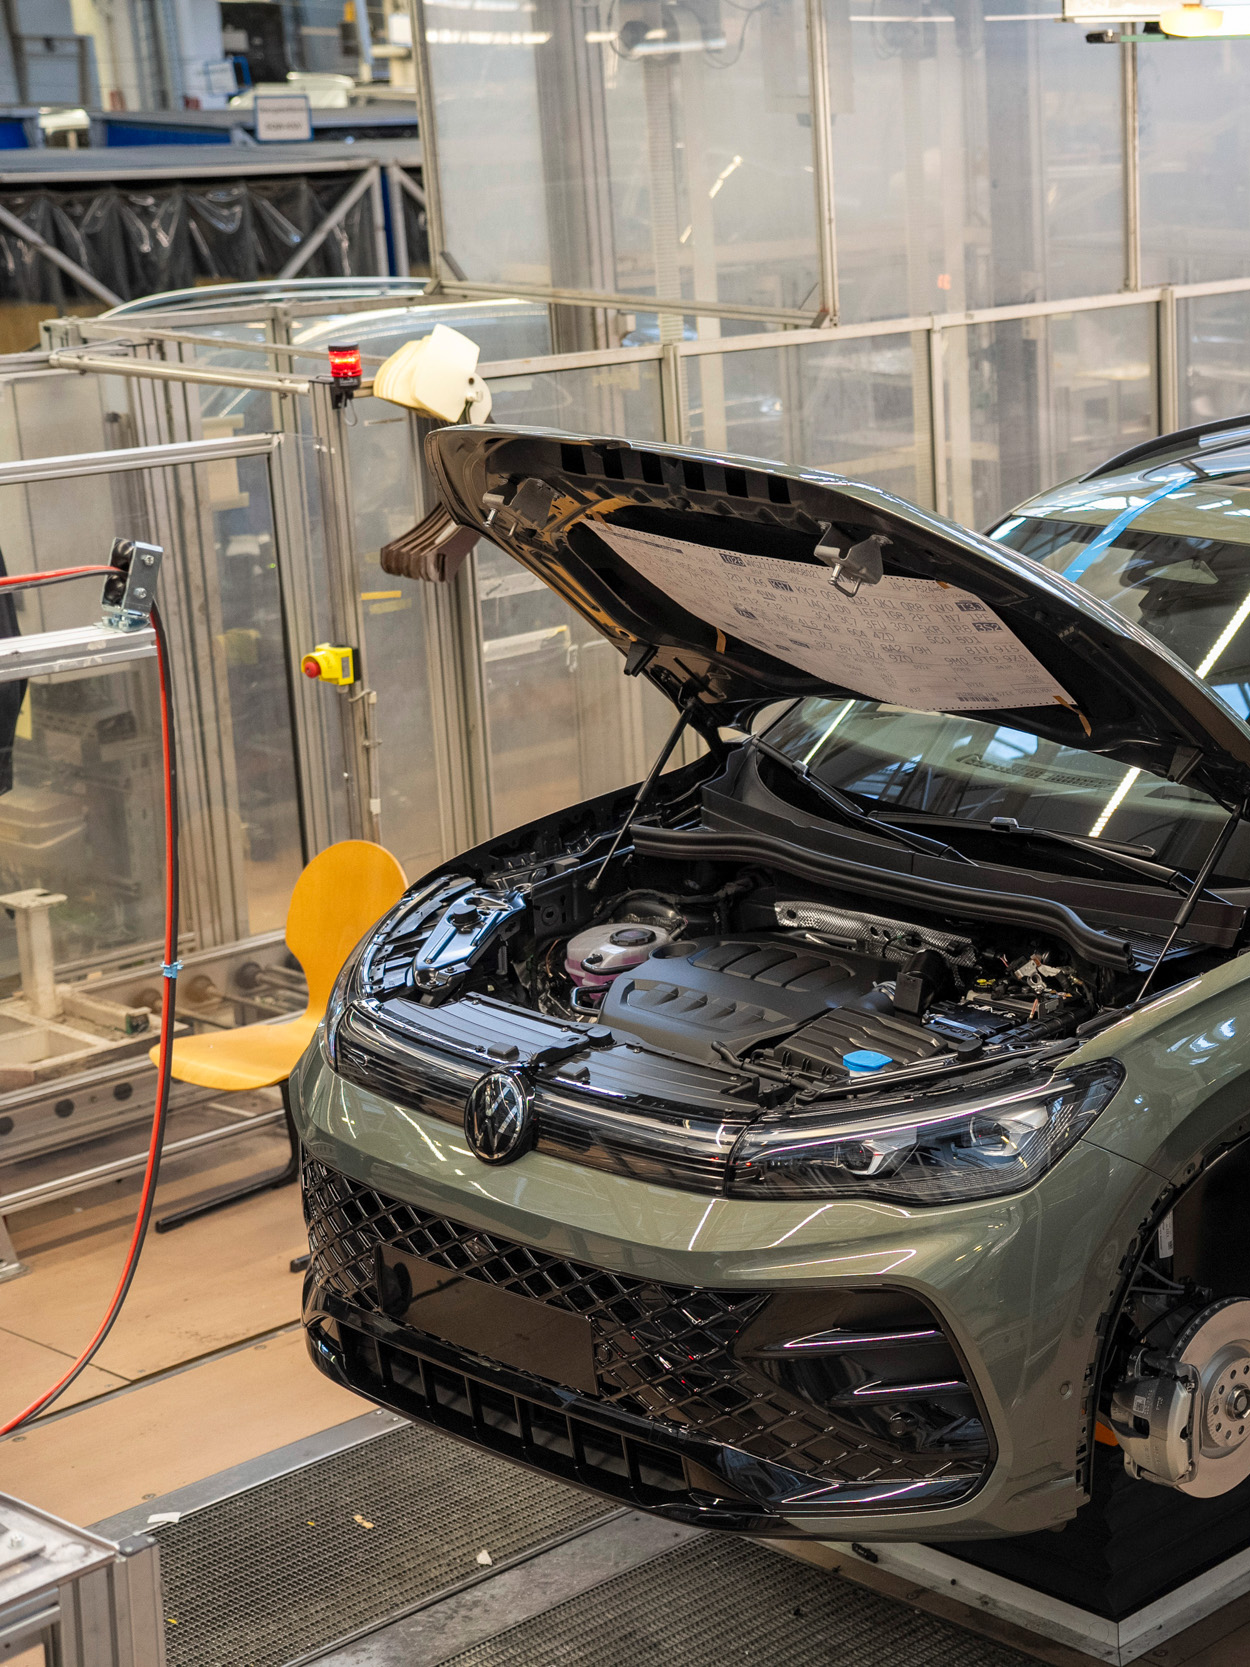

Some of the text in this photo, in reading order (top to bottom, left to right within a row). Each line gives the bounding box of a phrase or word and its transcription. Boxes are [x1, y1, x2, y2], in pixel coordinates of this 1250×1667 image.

[856, 607, 879, 618] 1E5
[909, 613, 932, 622] 2PT
[938, 614, 961, 623] 1N7
[967, 613, 993, 622] 1PE
[863, 619, 887, 630] 3FU
[890, 622, 914, 632] 3GD
[947, 625, 973, 634] 1R8
[973, 623, 1002, 632] 3S2
[873, 632, 895, 642] 4ZD
[907, 645, 933, 655] 79H
